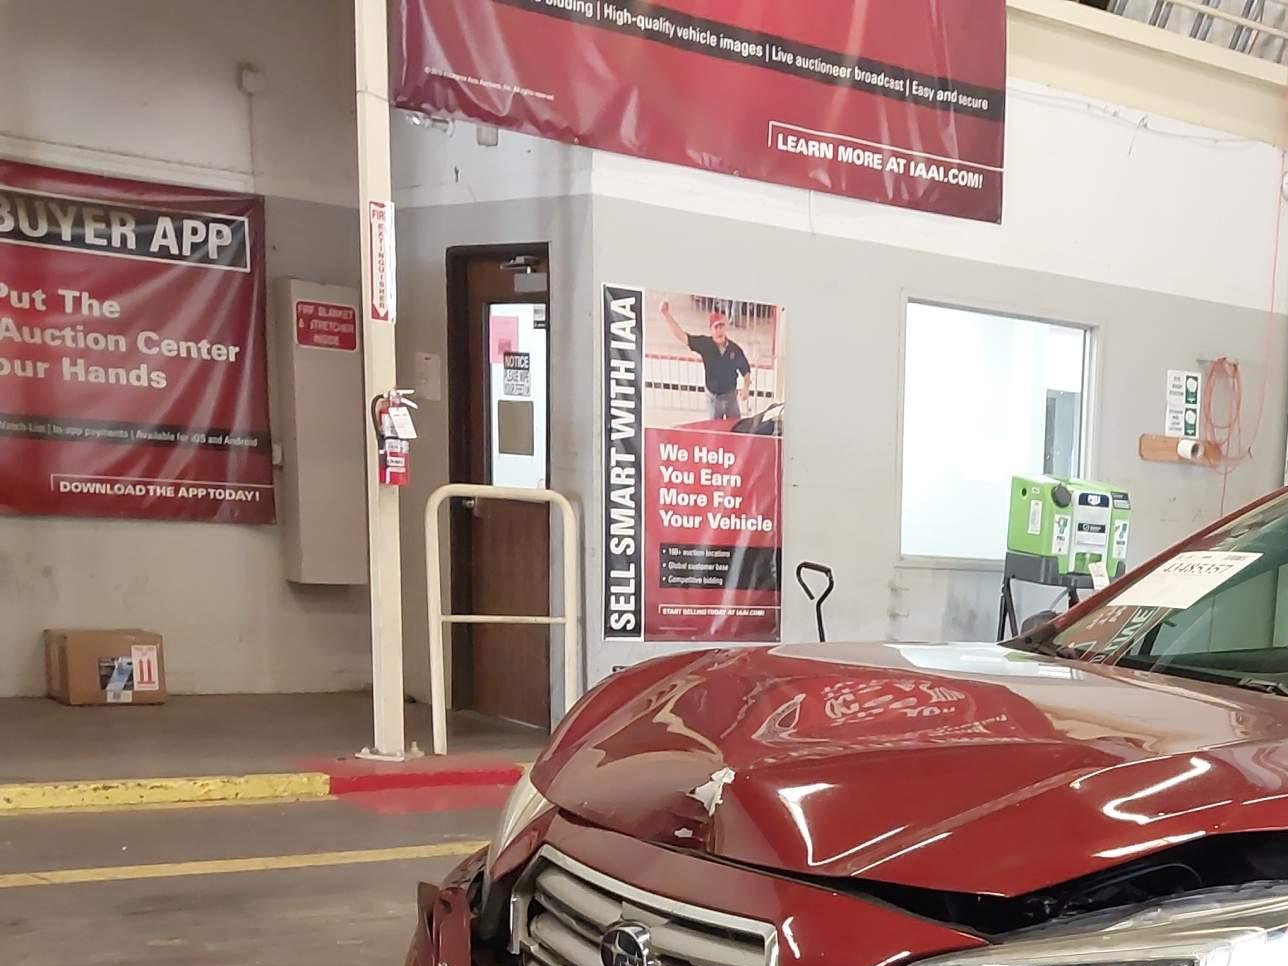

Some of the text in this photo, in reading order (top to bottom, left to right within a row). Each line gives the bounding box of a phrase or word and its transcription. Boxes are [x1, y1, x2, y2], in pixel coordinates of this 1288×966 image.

[604, 7, 677, 38] High-quality
[677, 26, 718, 47] vehicle
[719, 34, 764, 57] images
[772, 45, 794, 64] Live
[796, 56, 852, 78] auctioneer
[855, 66, 904, 92] broadcast
[912, 82, 935, 101] Easy
[937, 88, 958, 103] and
[958, 94, 989, 110] secure
[777, 133, 983, 188] LEARN MORE AT IAAI.COM!
[150, 216, 233, 260] APP
[58, 288, 121, 318] The
[0, 317, 241, 361] Auction Center
[62, 356, 168, 388] Hands
[504, 355, 529, 369] NOTICE
[610, 296, 637, 631] SELL SMART WITH IAA
[659, 443, 736, 469] We Help
[60, 480, 260, 502] DOWNLOAD THE APP TODAY!
[660, 466, 742, 487] You Earn
[659, 488, 743, 509] More For
[659, 510, 773, 532] Your Vehicle
